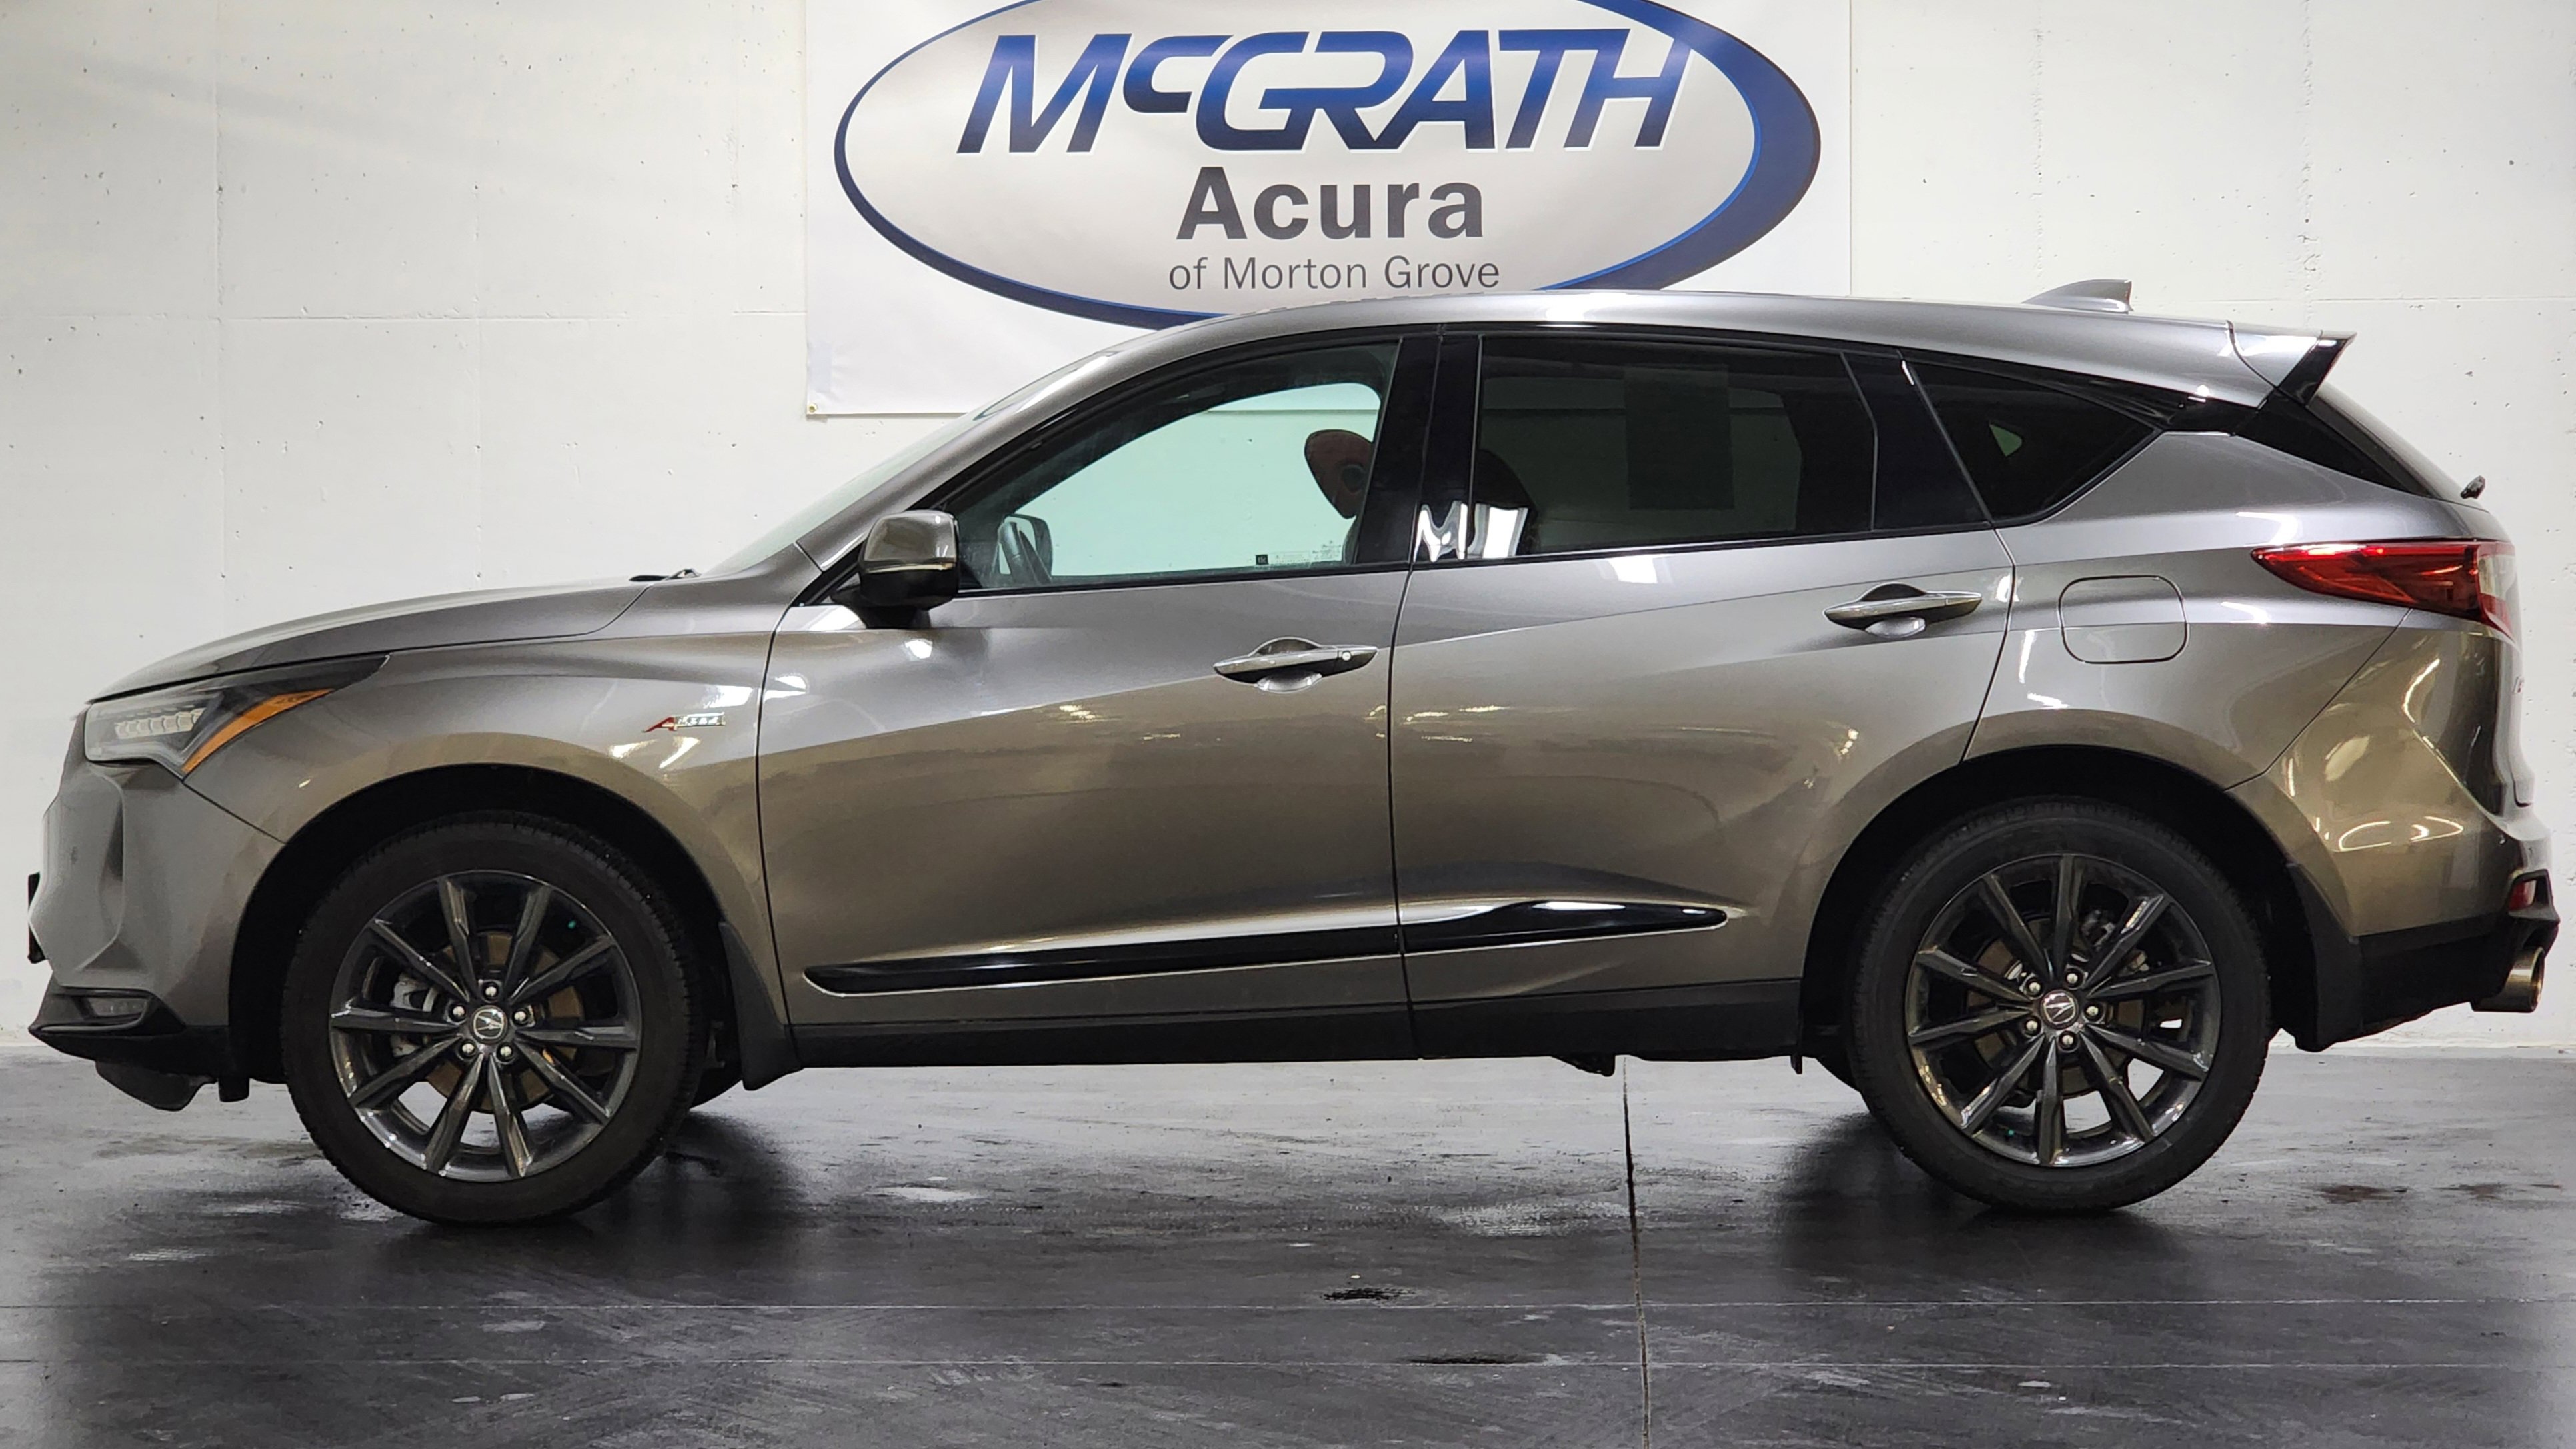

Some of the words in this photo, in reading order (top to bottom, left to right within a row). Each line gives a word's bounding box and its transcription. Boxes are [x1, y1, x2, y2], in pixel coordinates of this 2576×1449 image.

[1176, 166, 1483, 240] Acura
[1169, 257, 1208, 290] of
[1224, 257, 1366, 289] Morton
[1384, 255, 1500, 289] Grove
